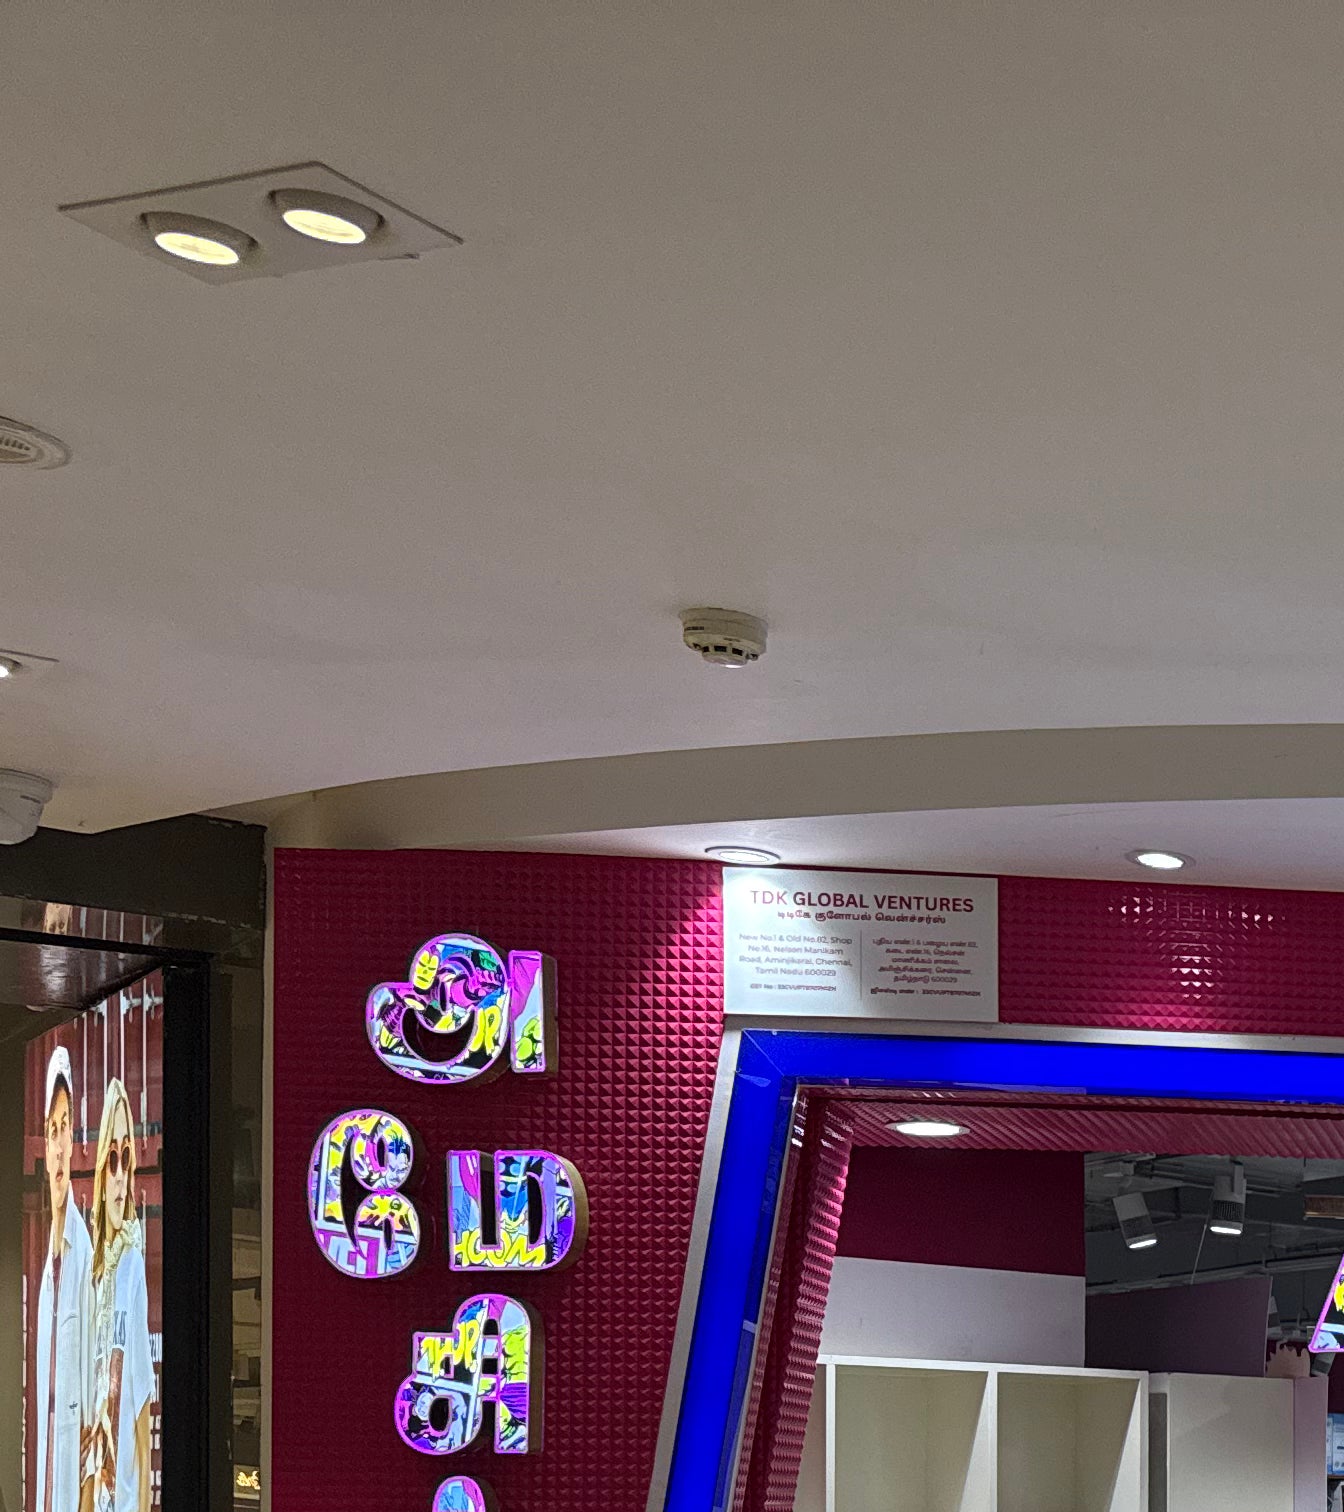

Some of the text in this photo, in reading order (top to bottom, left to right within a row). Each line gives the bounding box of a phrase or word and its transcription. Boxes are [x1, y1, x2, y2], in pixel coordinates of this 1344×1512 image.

[750, 891, 975, 912] TDK GLOBAL VENTURES
[830, 936, 853, 945] Shop
